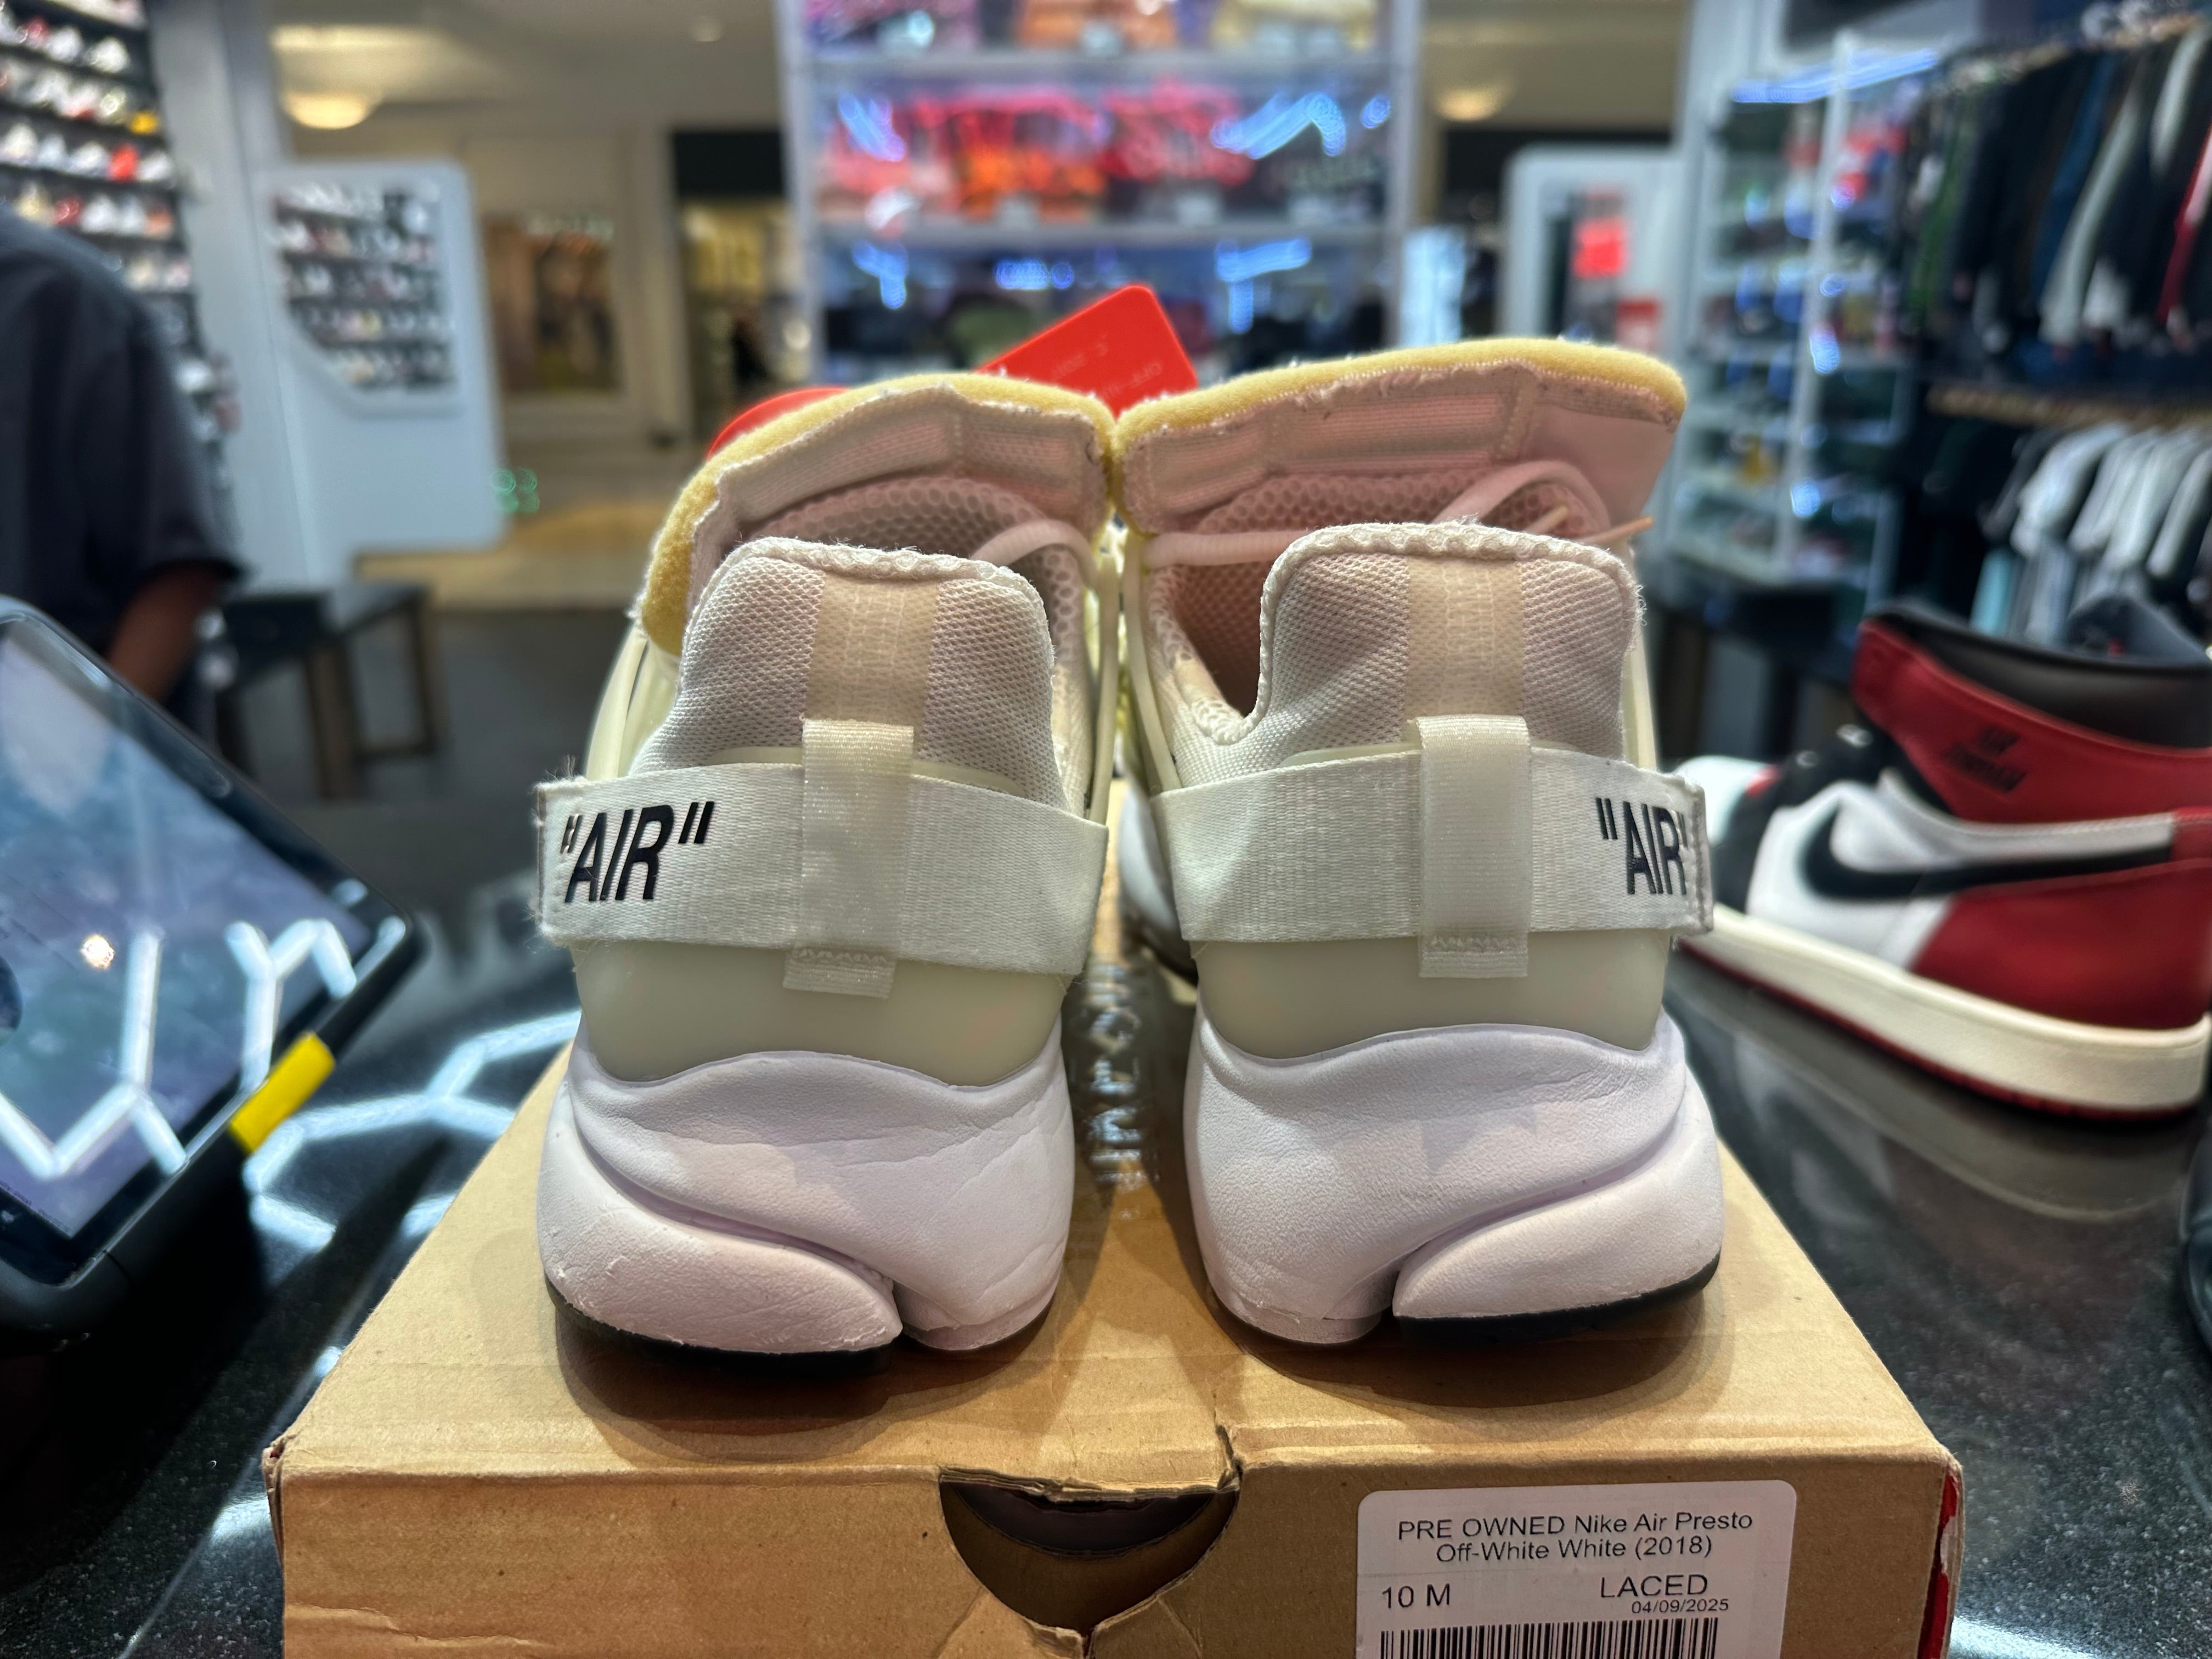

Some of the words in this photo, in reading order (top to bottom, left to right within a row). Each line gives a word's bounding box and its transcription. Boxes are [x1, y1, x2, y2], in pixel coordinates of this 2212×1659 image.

[1398, 1519, 1452, 1540] PRE
[1462, 1516, 1564, 1537] OWNED
[1575, 1514, 1627, 1533] Nike
[1633, 1513, 1667, 1532] Air
[1675, 1511, 1753, 1530] Presto
[1436, 1541, 1549, 1562] Off-White
[1558, 1538, 1626, 1558] White
[1635, 1536, 1712, 1560] (2018)
[1382, 1585, 1414, 1609] 10
[1426, 1583, 1450, 1607] M
[1600, 1574, 1708, 1598] LACED
[1631, 1598, 1729, 1614] 04/09/2025
